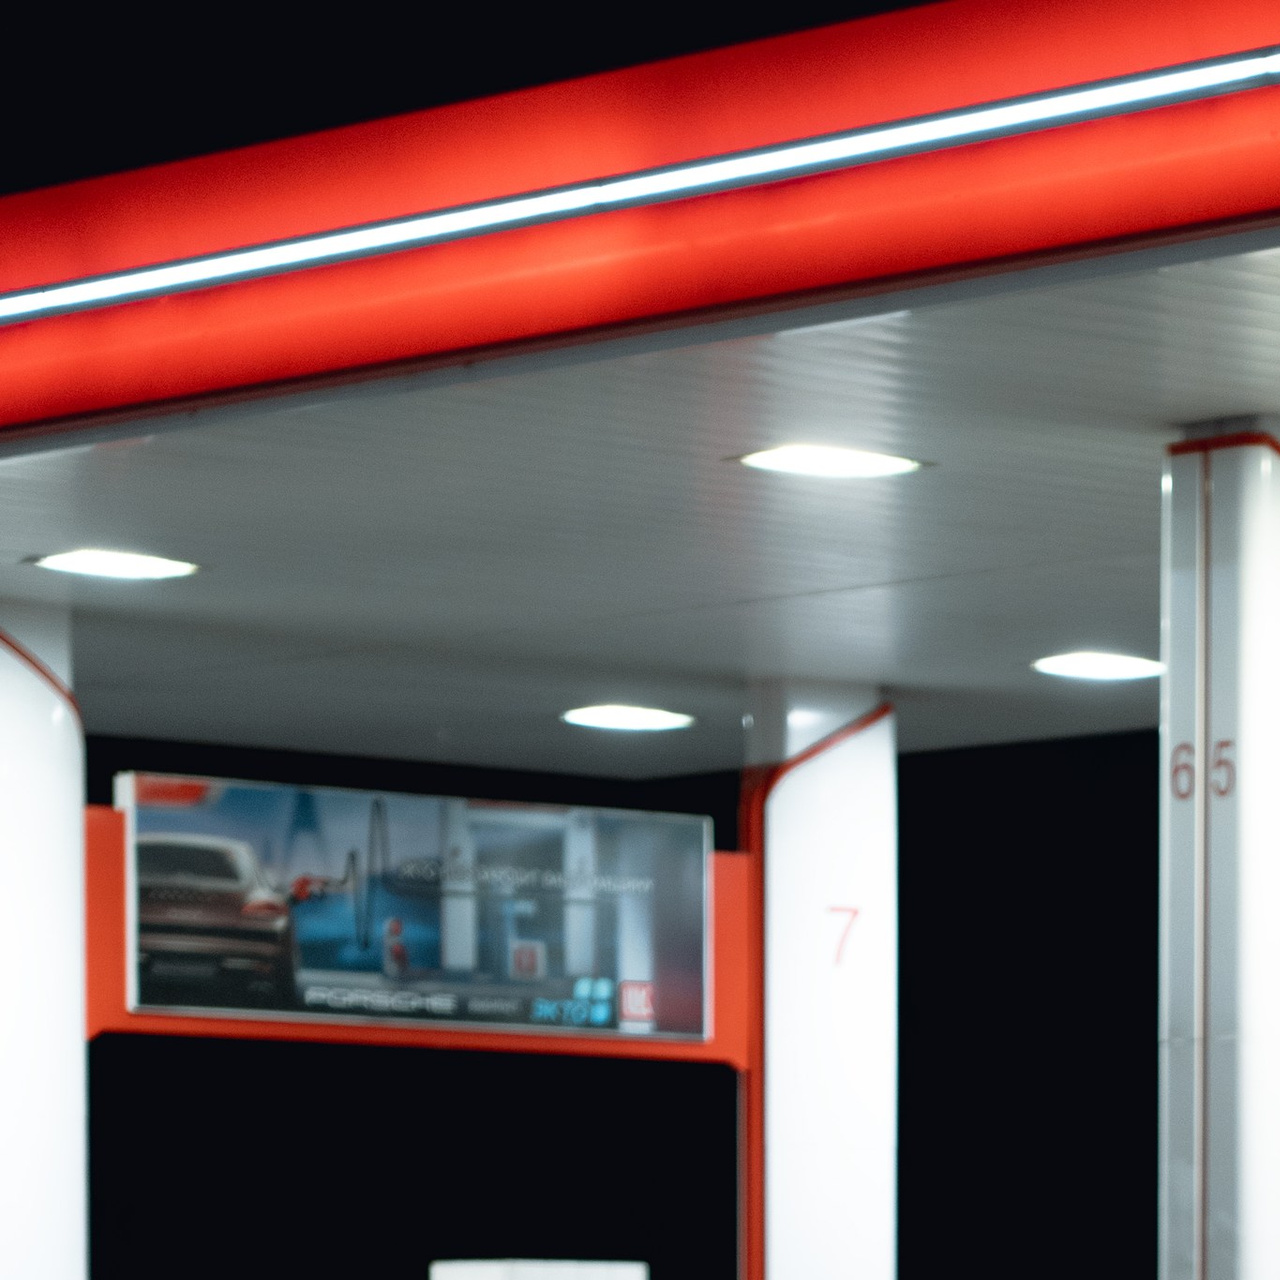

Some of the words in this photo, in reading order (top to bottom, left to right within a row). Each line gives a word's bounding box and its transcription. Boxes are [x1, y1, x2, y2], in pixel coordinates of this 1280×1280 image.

[1169, 742, 1196, 802] 6
[1210, 739, 1237, 798] 5
[826, 906, 860, 967] 7
